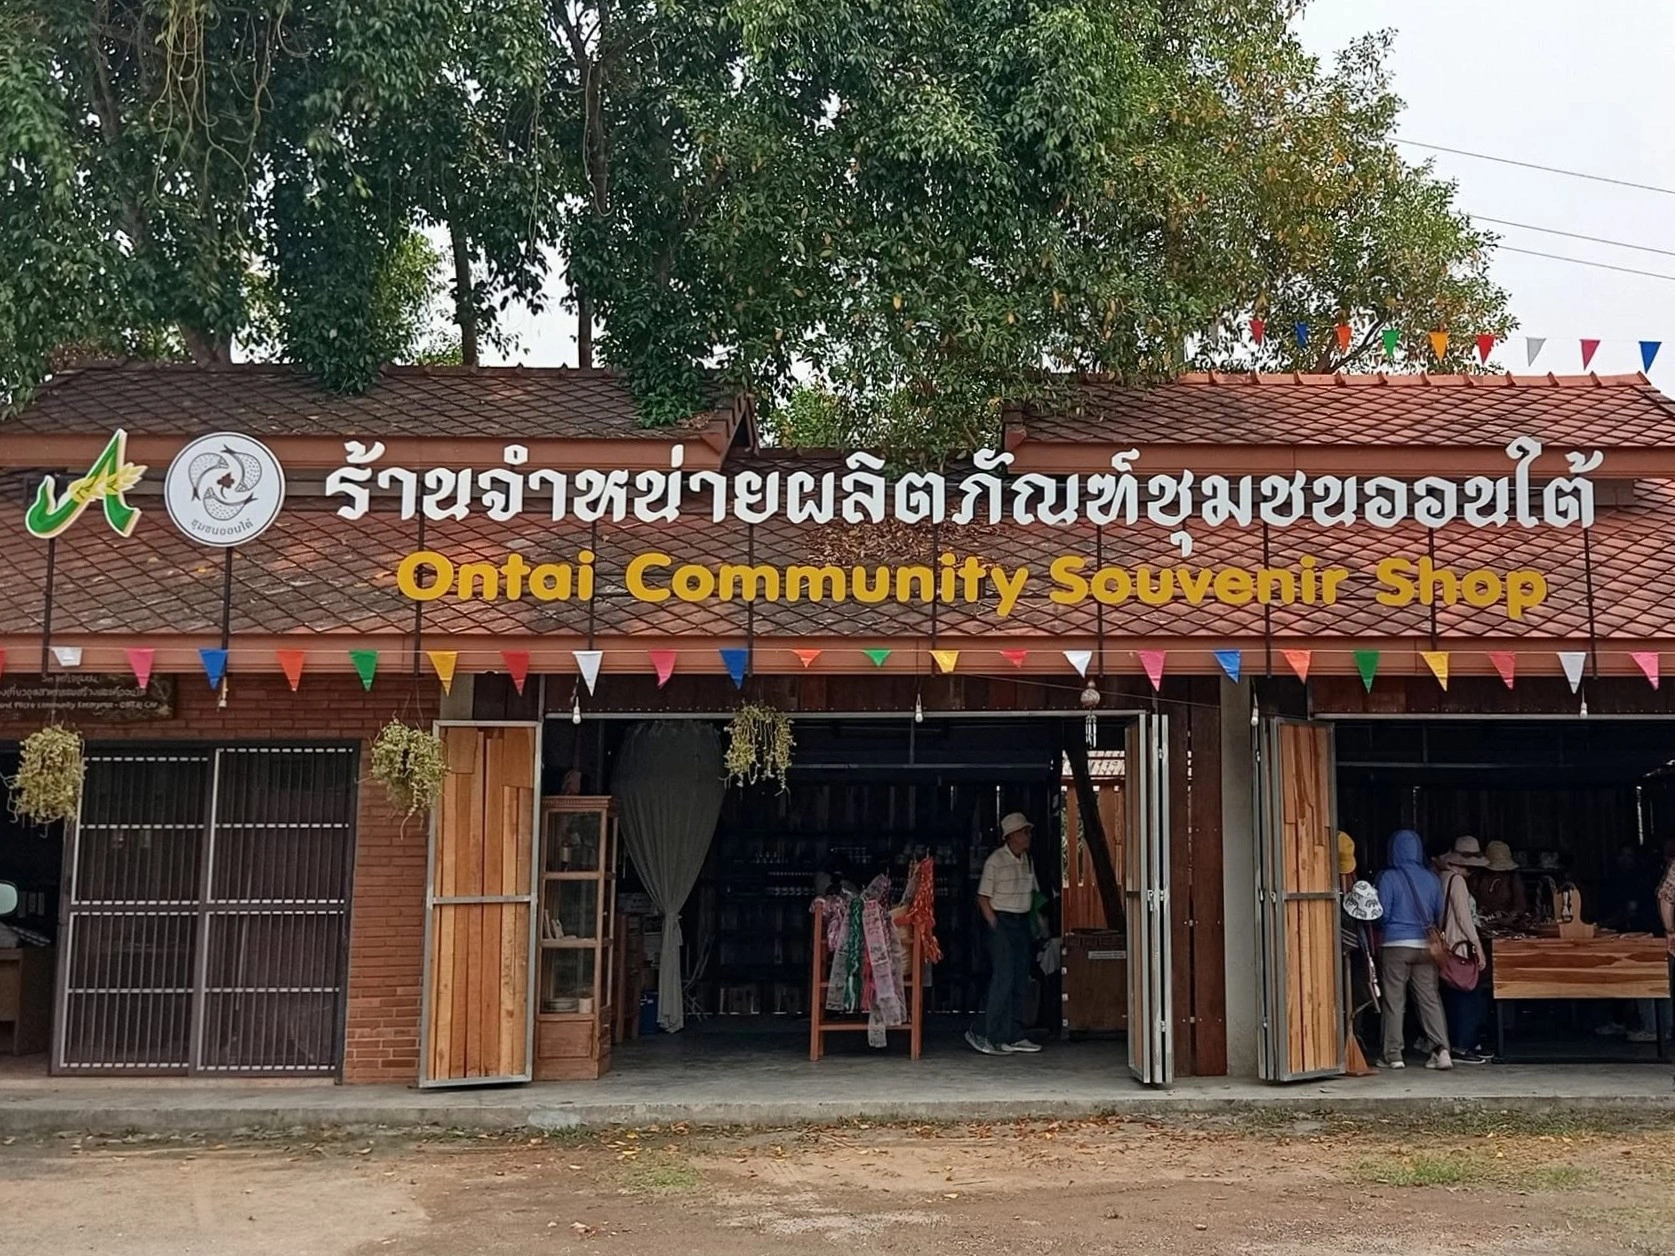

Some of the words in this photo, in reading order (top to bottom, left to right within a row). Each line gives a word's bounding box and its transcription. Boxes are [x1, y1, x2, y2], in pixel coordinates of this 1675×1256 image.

[324, 436, 1604, 558] ร้านจำหน่ายผลิตภัณฑ์ชุมชนออนใต้
[396, 550, 595, 602] Ontai
[625, 552, 1028, 618] Community
[1049, 554, 1349, 606] Souvenir
[1375, 556, 1548, 620] Shop
